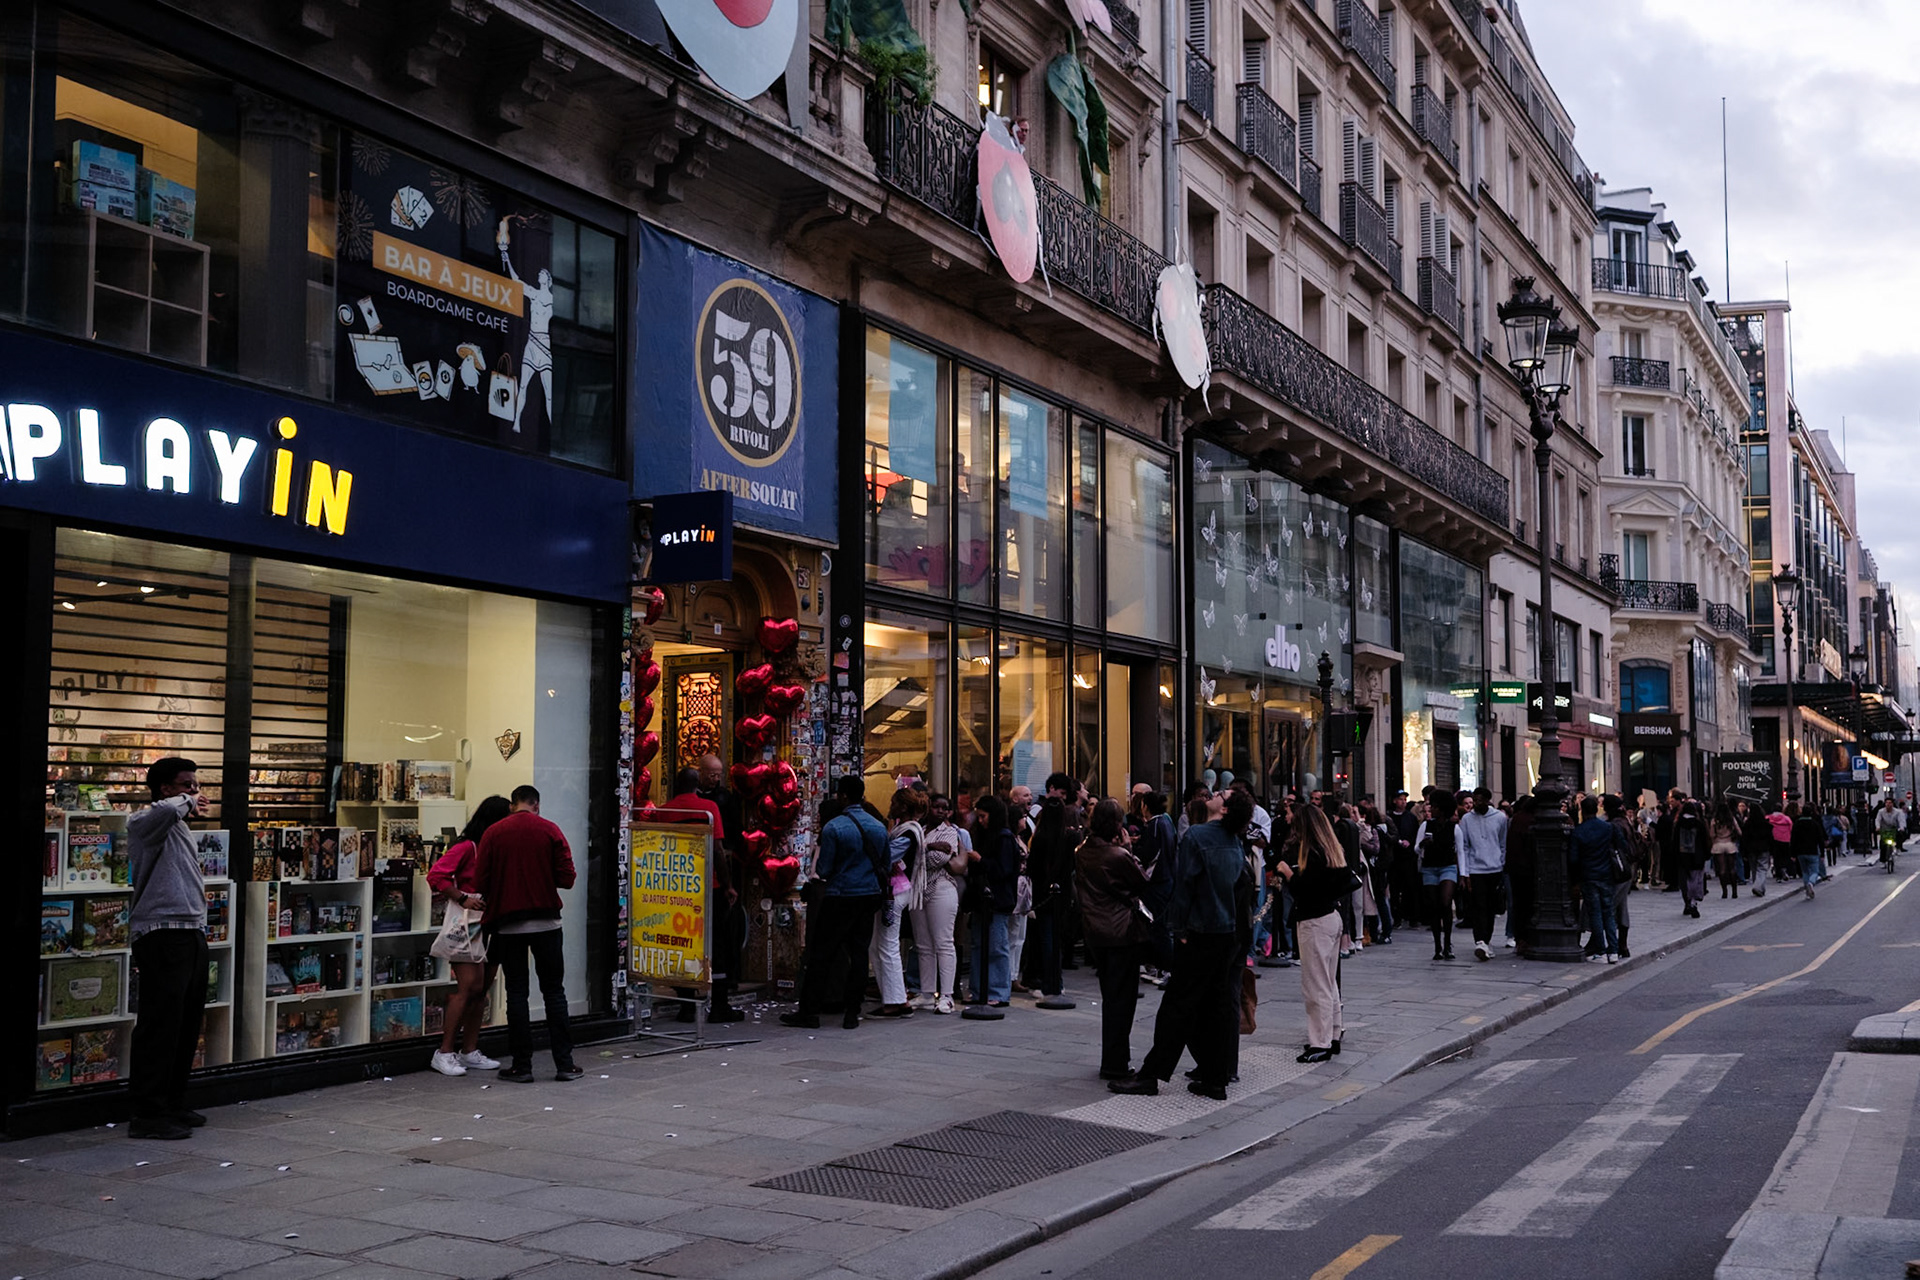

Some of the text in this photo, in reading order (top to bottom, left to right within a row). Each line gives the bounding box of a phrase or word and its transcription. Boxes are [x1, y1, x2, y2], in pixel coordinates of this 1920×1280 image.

[385, 246, 513, 308] BAR À JEUX
[386, 280, 510, 334] BOARDGAME CAFÉ
[710, 308, 793, 430] 59
[729, 424, 770, 452] RIVOLI
[1265, 624, 1301, 673] elho
[1633, 725, 1673, 735] BERSHKA
[1722, 761, 1771, 771] FOOTSHOP
[1856, 758, 1864, 769] P
[71, 836, 109, 845] MONOPOLY
[642, 852, 695, 874] ATELIERS
[635, 871, 701, 894] D'ARTISTES
[649, 894, 668, 906] ARTIST
[669, 895, 693, 907] STUDIOS
[672, 912, 704, 939] OUI
[656, 934, 670, 944] FREE
[631, 946, 684, 977] ENTREZ
